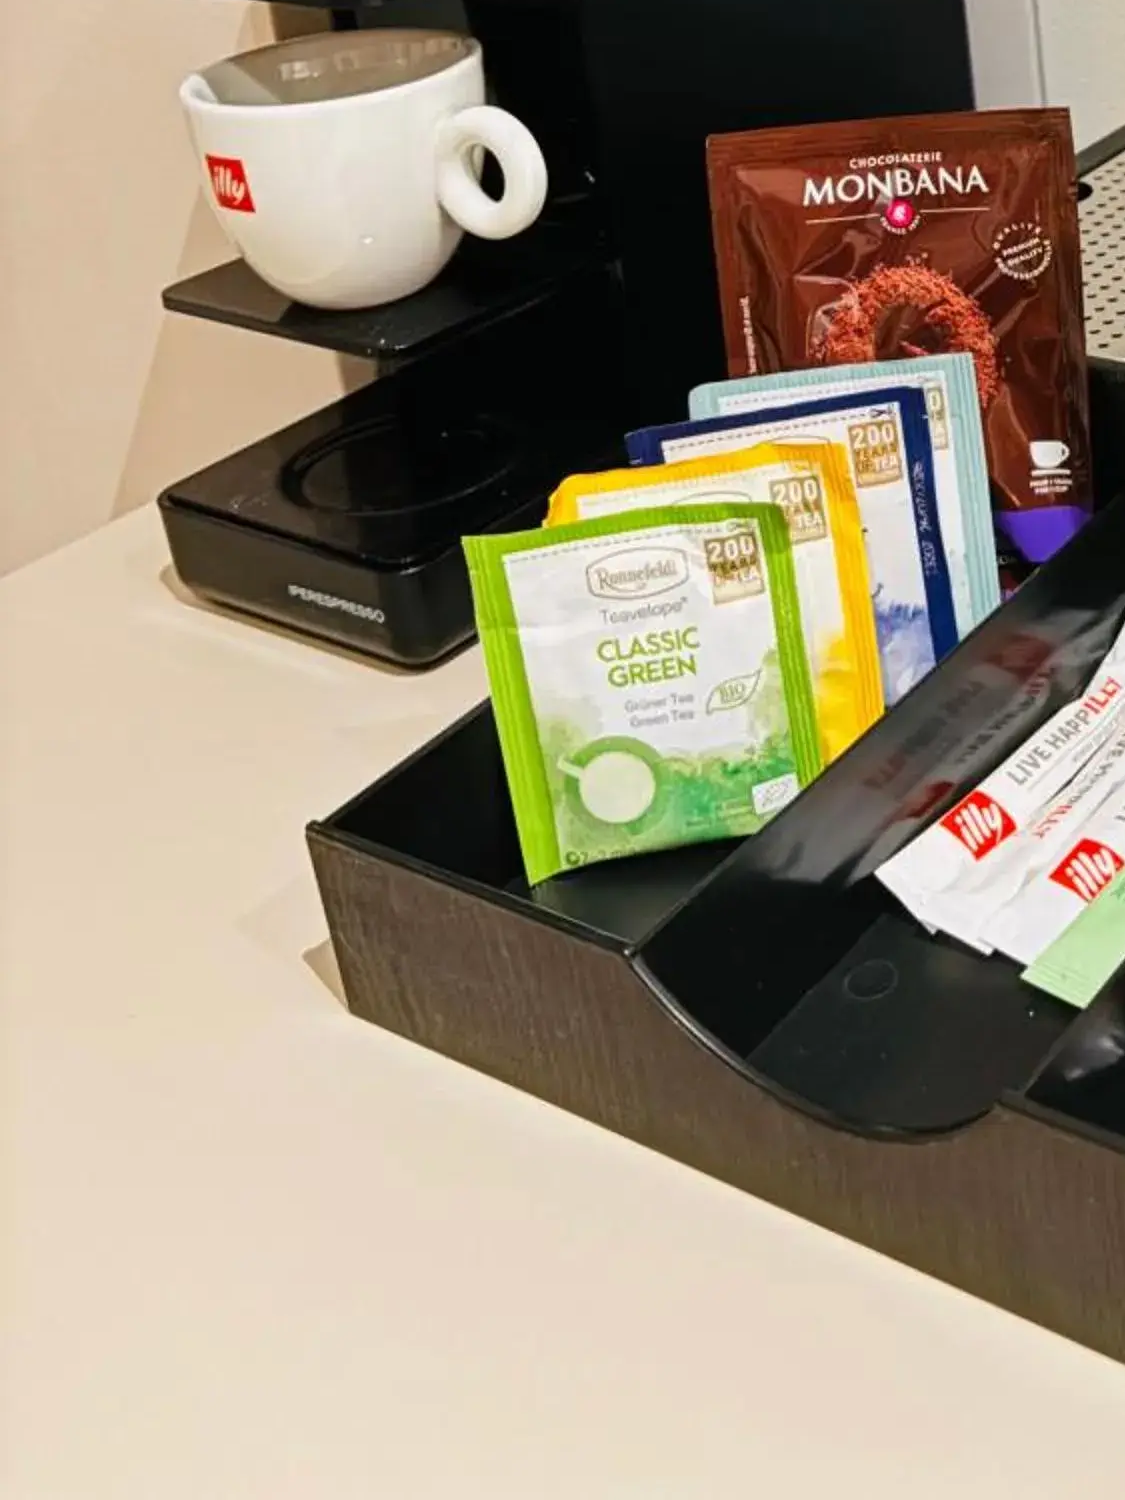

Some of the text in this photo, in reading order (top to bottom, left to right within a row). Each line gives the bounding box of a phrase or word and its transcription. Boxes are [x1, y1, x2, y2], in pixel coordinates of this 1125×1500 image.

[850, 151, 943, 170] CHOCOLATERIE
[214, 165, 245, 206] illy
[803, 164, 989, 207] MONBANA
[850, 422, 896, 451] 200
[772, 479, 818, 504] 200
[707, 535, 755, 564] 200
[596, 625, 701, 663] CLASSIC
[607, 653, 697, 688] GREEN
[1006, 743, 1053, 787] LIVE
[955, 800, 1003, 851] illy
[1067, 849, 1117, 902] illy
